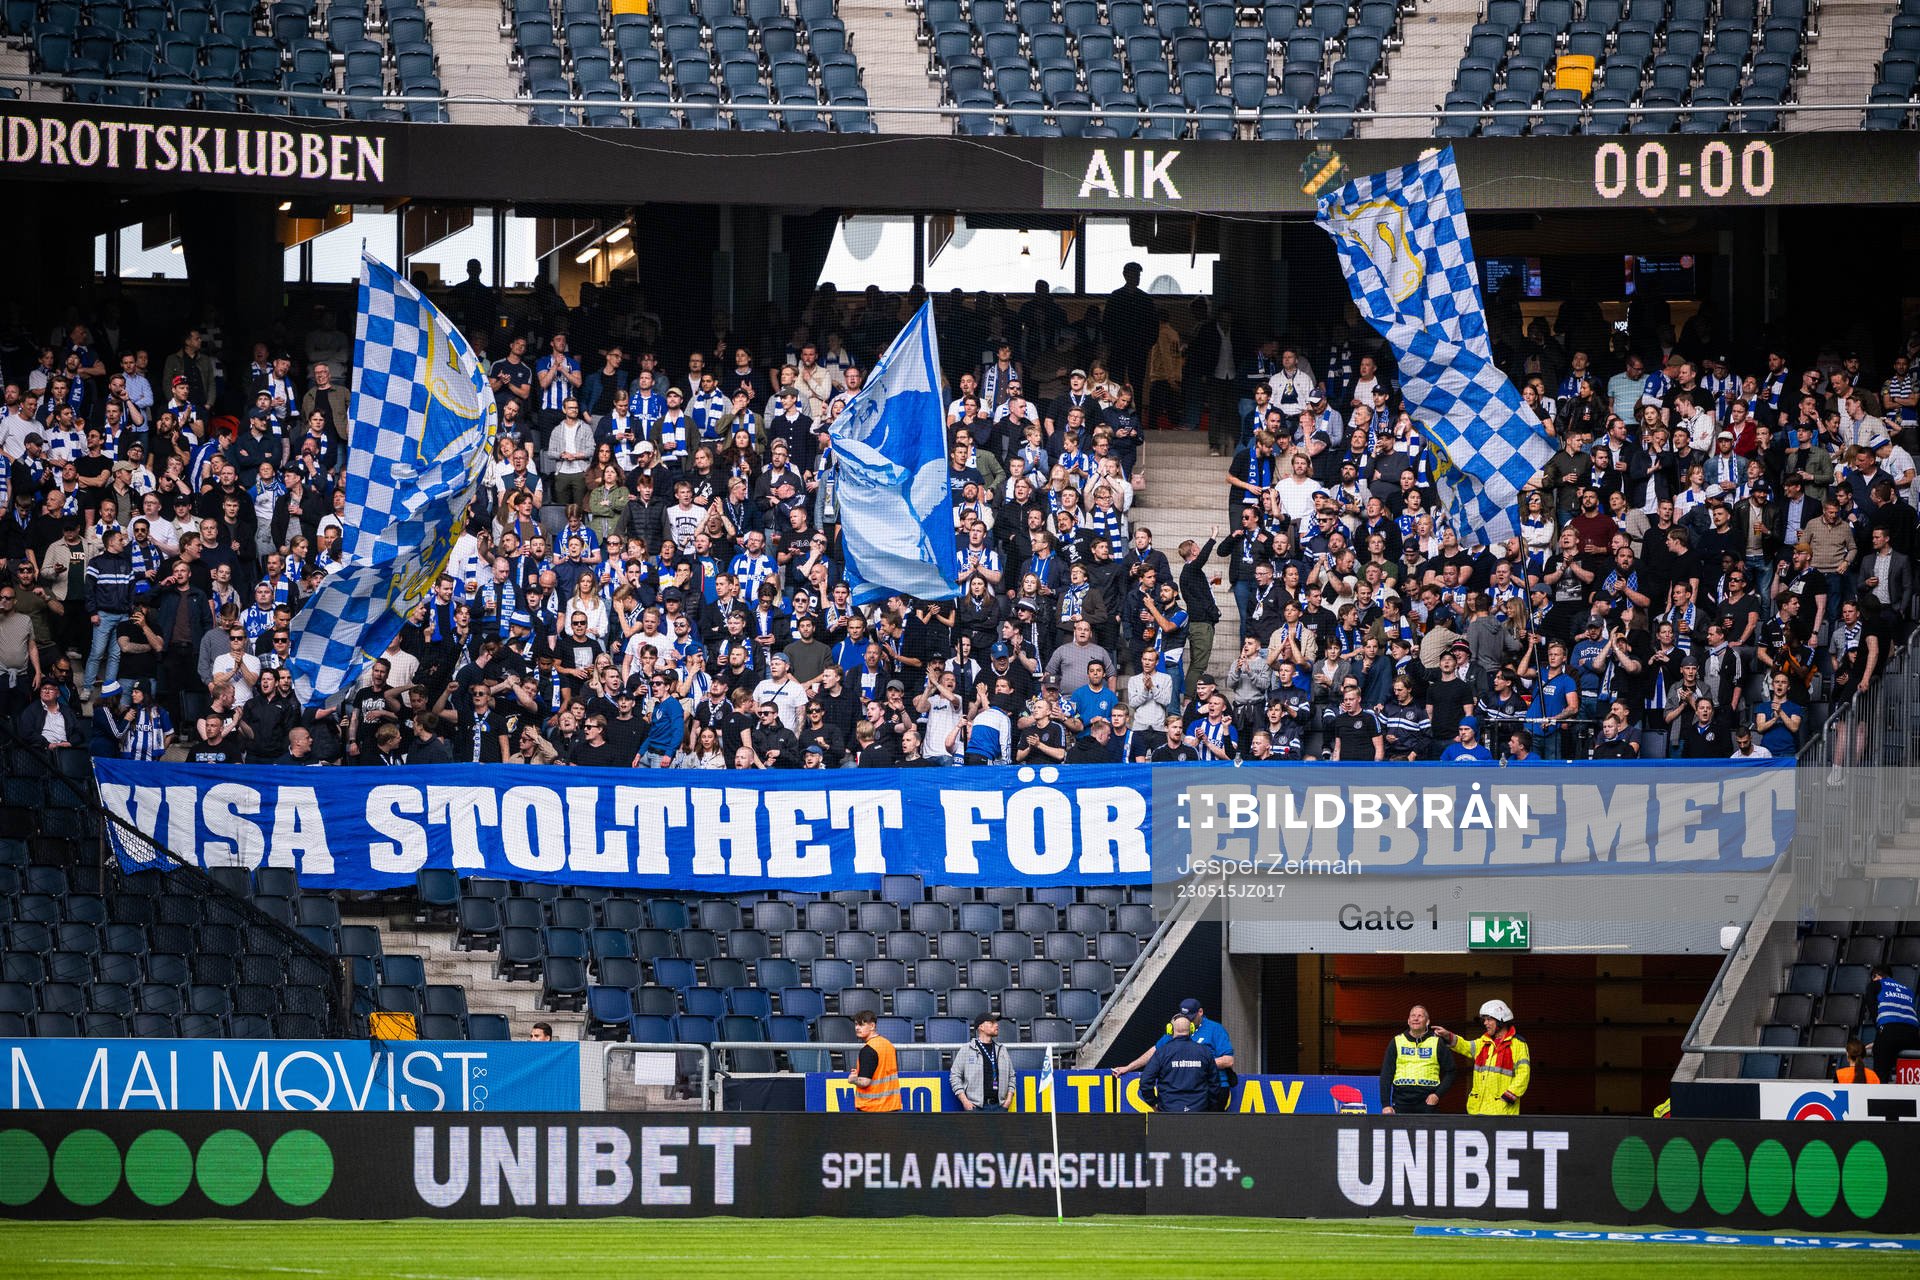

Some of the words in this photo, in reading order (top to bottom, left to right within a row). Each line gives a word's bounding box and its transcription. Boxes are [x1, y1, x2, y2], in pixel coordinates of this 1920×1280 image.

[1078, 149, 1182, 199] AIK
[1595, 140, 1774, 198] 00:00
[101, 782, 335, 874] VISA
[365, 784, 902, 878] STOLTHET
[940, 766, 1152, 875] FÖR
[1185, 769, 1797, 866] EMBLEMET
[1338, 904, 1415, 930] Gate
[1426, 905, 1438, 929] 1
[1403, 1047, 1430, 1056] POLIS
[413, 1126, 752, 1208] UNIBET
[821, 1152, 922, 1190] SPELA
[931, 1152, 1170, 1190] ANSVARSFULLT
[1337, 1129, 1569, 1210] UNIBET
